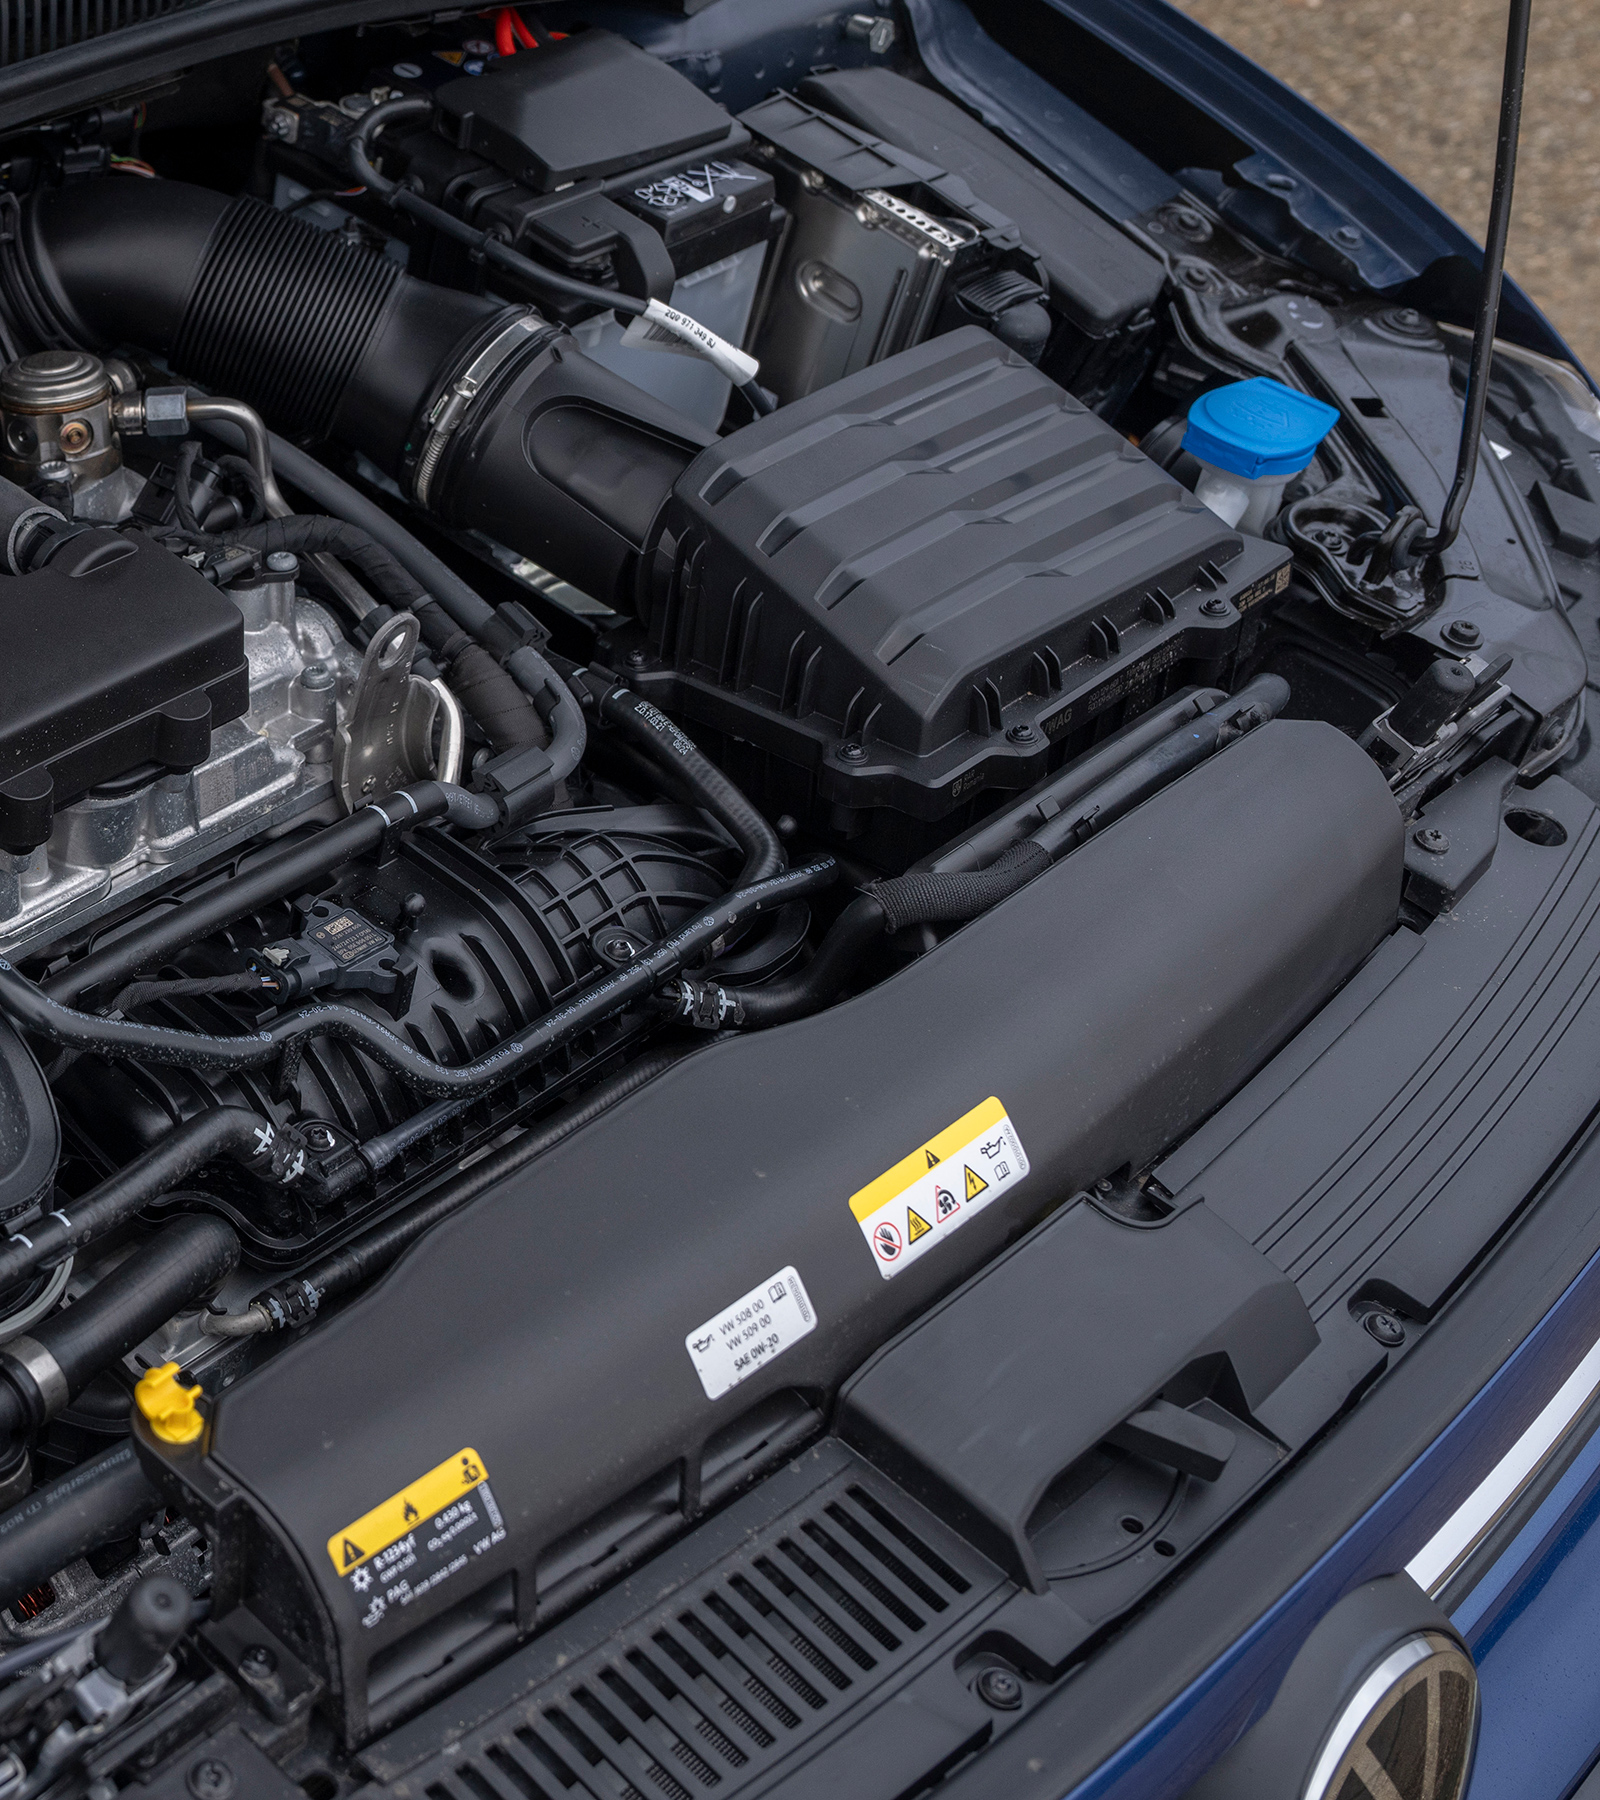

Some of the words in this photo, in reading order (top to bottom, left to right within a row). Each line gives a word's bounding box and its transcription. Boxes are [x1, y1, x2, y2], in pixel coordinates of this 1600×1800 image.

[679, 316, 695, 330] 971
[692, 326, 708, 341] 349
[718, 1318, 736, 1335] VW
[733, 1306, 754, 1324] 508
[750, 1297, 766, 1313] 00
[725, 1334, 744, 1350] VW
[740, 1322, 760, 1339] 509
[757, 1312, 773, 1328] 00
[732, 1352, 753, 1371] SAE
[747, 1332, 781, 1360] 0W-20
[383, 1578, 412, 1603] PAG
